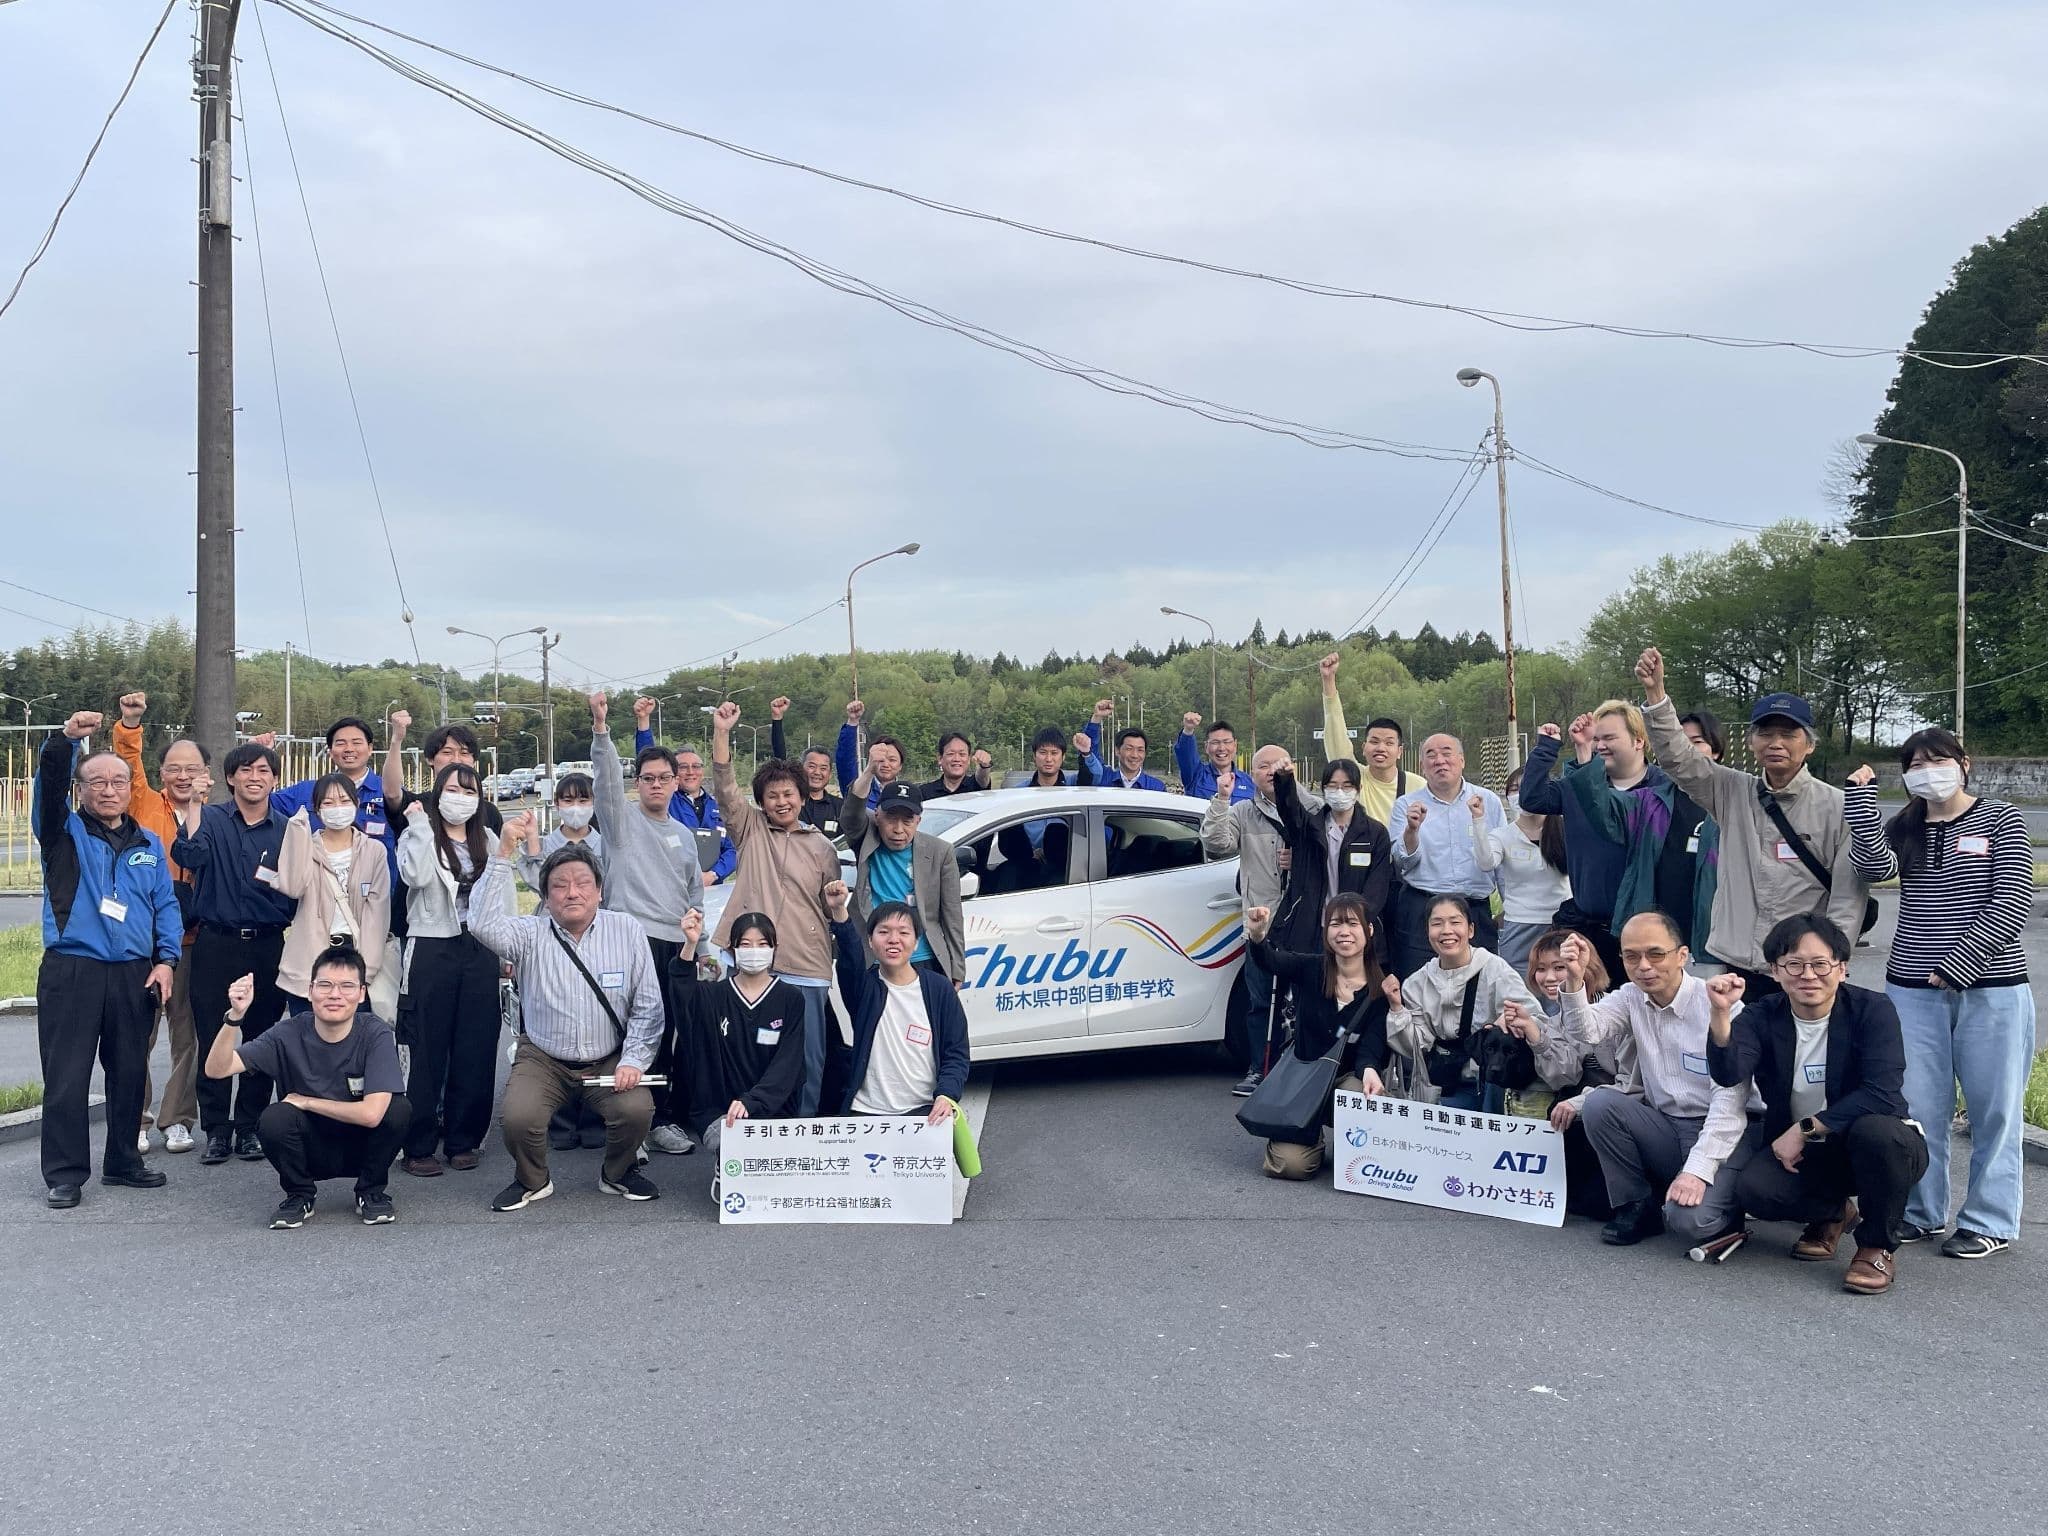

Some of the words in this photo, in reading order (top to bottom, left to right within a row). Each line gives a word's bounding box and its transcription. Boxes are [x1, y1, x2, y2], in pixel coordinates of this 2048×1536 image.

[995, 978, 1176, 1012] 栃木県中部自動車学校
[1337, 1095, 1410, 1118] 視覚障害者
[1423, 1109, 1556, 1135] 自動車運転ツアー
[744, 1122, 925, 1138] 手引き介助ボランティア
[1372, 1136, 1473, 1161] 日本介護トラベルサービス
[743, 1157, 851, 1172] 国際医療福祉大学
[892, 1156, 947, 1171] 帝京大学
[1493, 1150, 1548, 1174] ATJ
[1361, 1164, 1418, 1184] Chubu
[1367, 1178, 1391, 1189] Driving
[1392, 1183, 1415, 1192] School
[770, 1196, 892, 1209] 宇都宮市社会福祉協議会
[1467, 1182, 1557, 1209] わかさ生活
